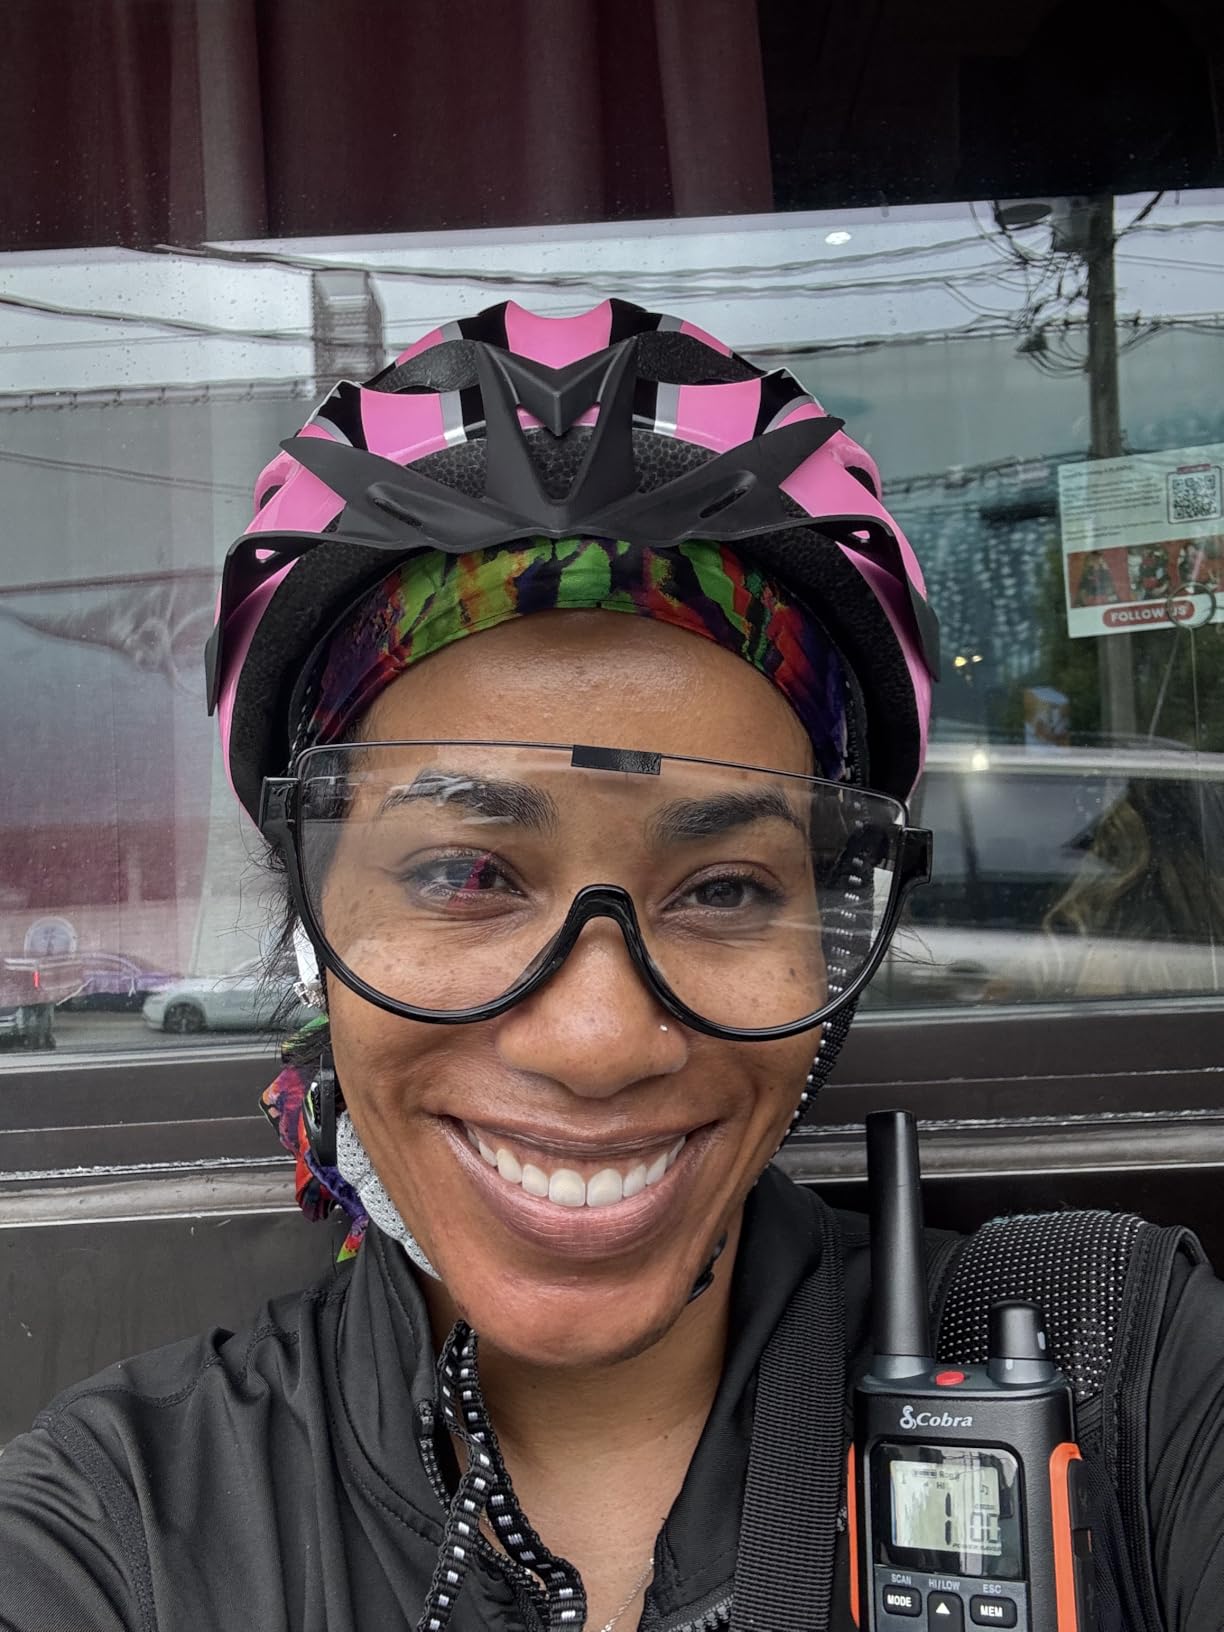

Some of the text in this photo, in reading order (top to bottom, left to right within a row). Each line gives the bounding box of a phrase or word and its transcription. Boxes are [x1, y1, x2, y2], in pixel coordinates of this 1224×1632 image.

[1111, 607, 1165, 622] FOLLOW
[916, 1412, 973, 1427] Cobra
[891, 1573, 912, 1585] SCAN
[928, 1578, 960, 1590] HI/LOW
[983, 1584, 1002, 1594] ESC
[887, 1594, 913, 1607] MODE
[980, 1604, 1003, 1617] MEM
